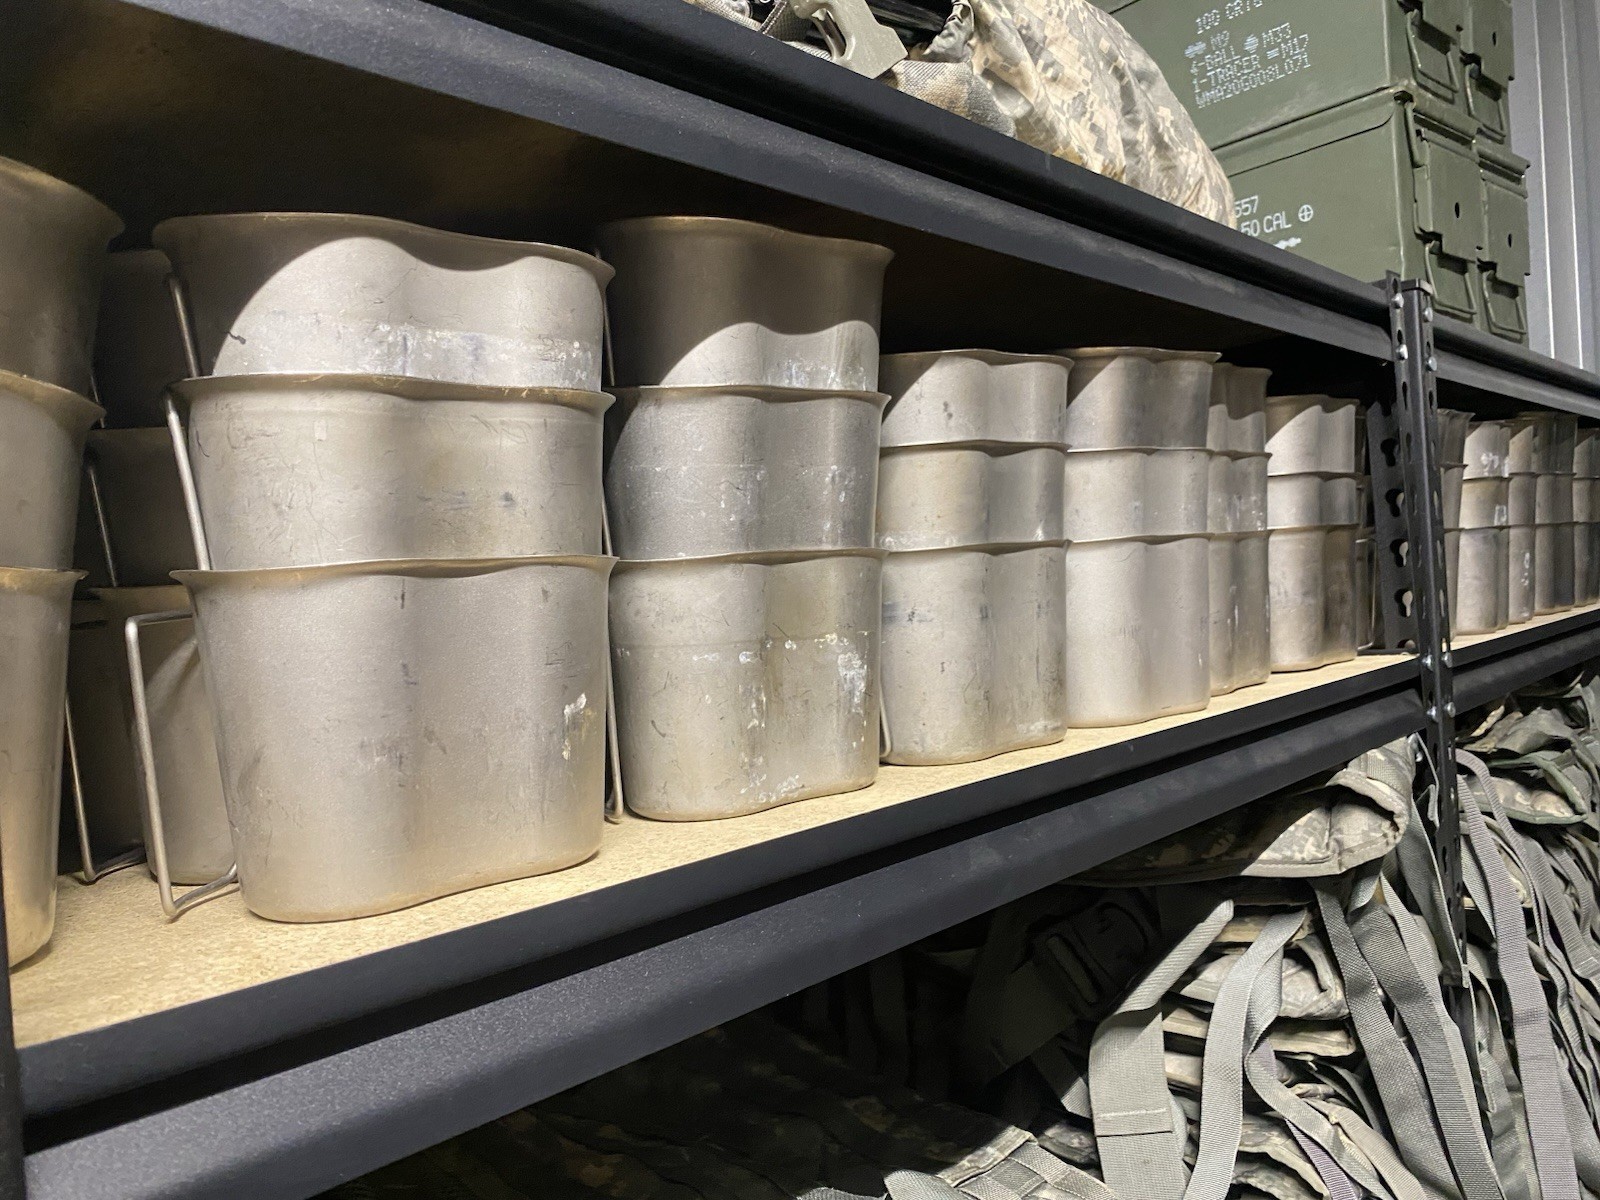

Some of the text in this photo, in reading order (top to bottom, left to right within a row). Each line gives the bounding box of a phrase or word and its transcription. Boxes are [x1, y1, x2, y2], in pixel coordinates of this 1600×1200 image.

[1195, 9, 1221, 35] 100
[1261, 22, 1292, 48] M33
[1280, 33, 1309, 59] M17
[1263, 211, 1292, 233] CAL
